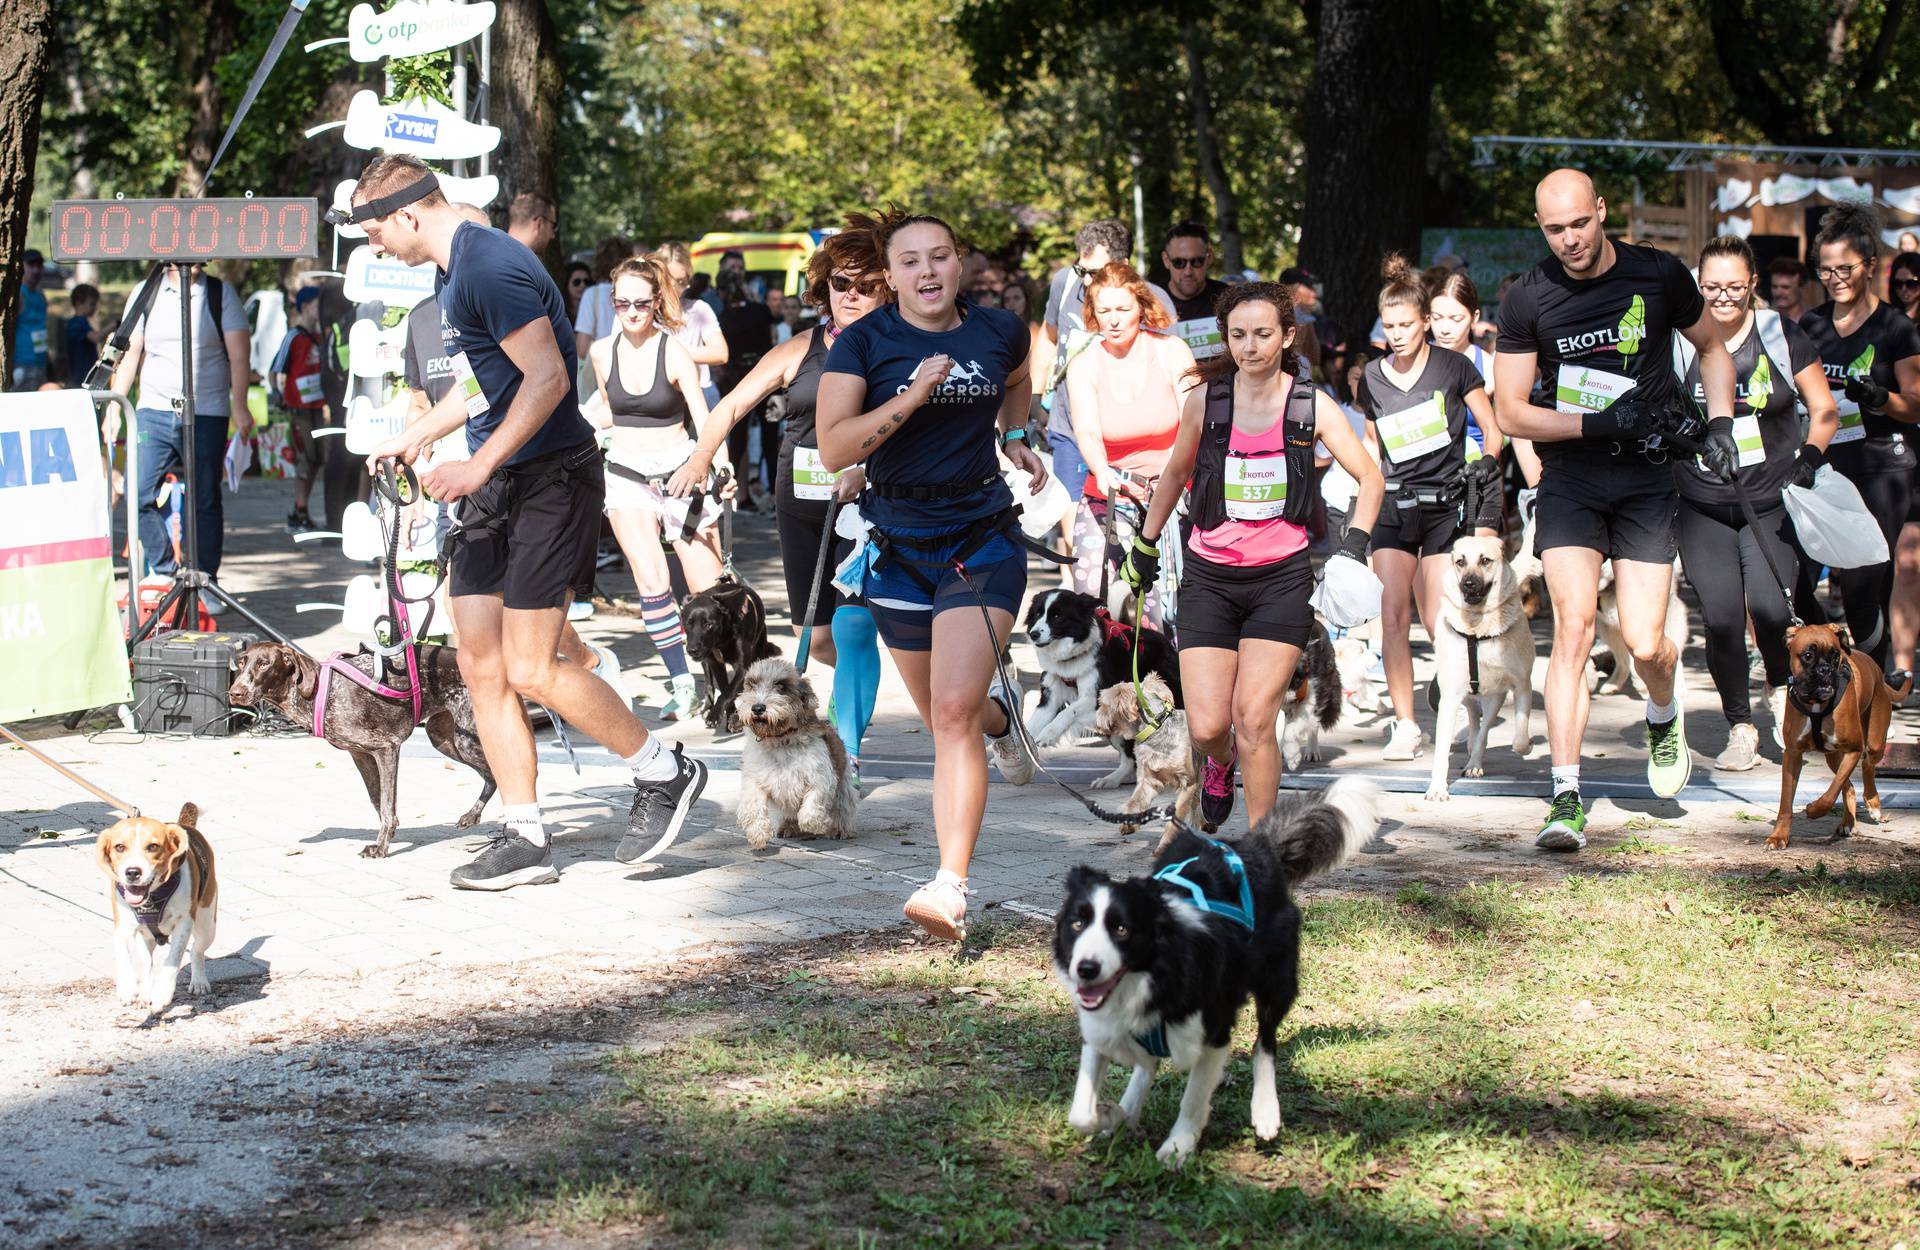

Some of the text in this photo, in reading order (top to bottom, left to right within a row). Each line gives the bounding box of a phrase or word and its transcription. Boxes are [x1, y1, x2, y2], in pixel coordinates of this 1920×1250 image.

[388, 20, 418, 41] otp
[395, 120, 436, 139] JYSK
[368, 268, 435, 287] DECATHLO
[1556, 324, 1647, 354] EKOTLON
[1822, 363, 1871, 382] OTLON
[896, 384, 998, 397] CICROSS
[1583, 380, 1614, 391] EKOTLON
[1694, 381, 1774, 397] ELON
[1579, 393, 1606, 409] 538
[810, 472, 835, 484] 506
[1243, 471, 1275, 479] EKOTLON
[1242, 485, 1272, 500] 537
